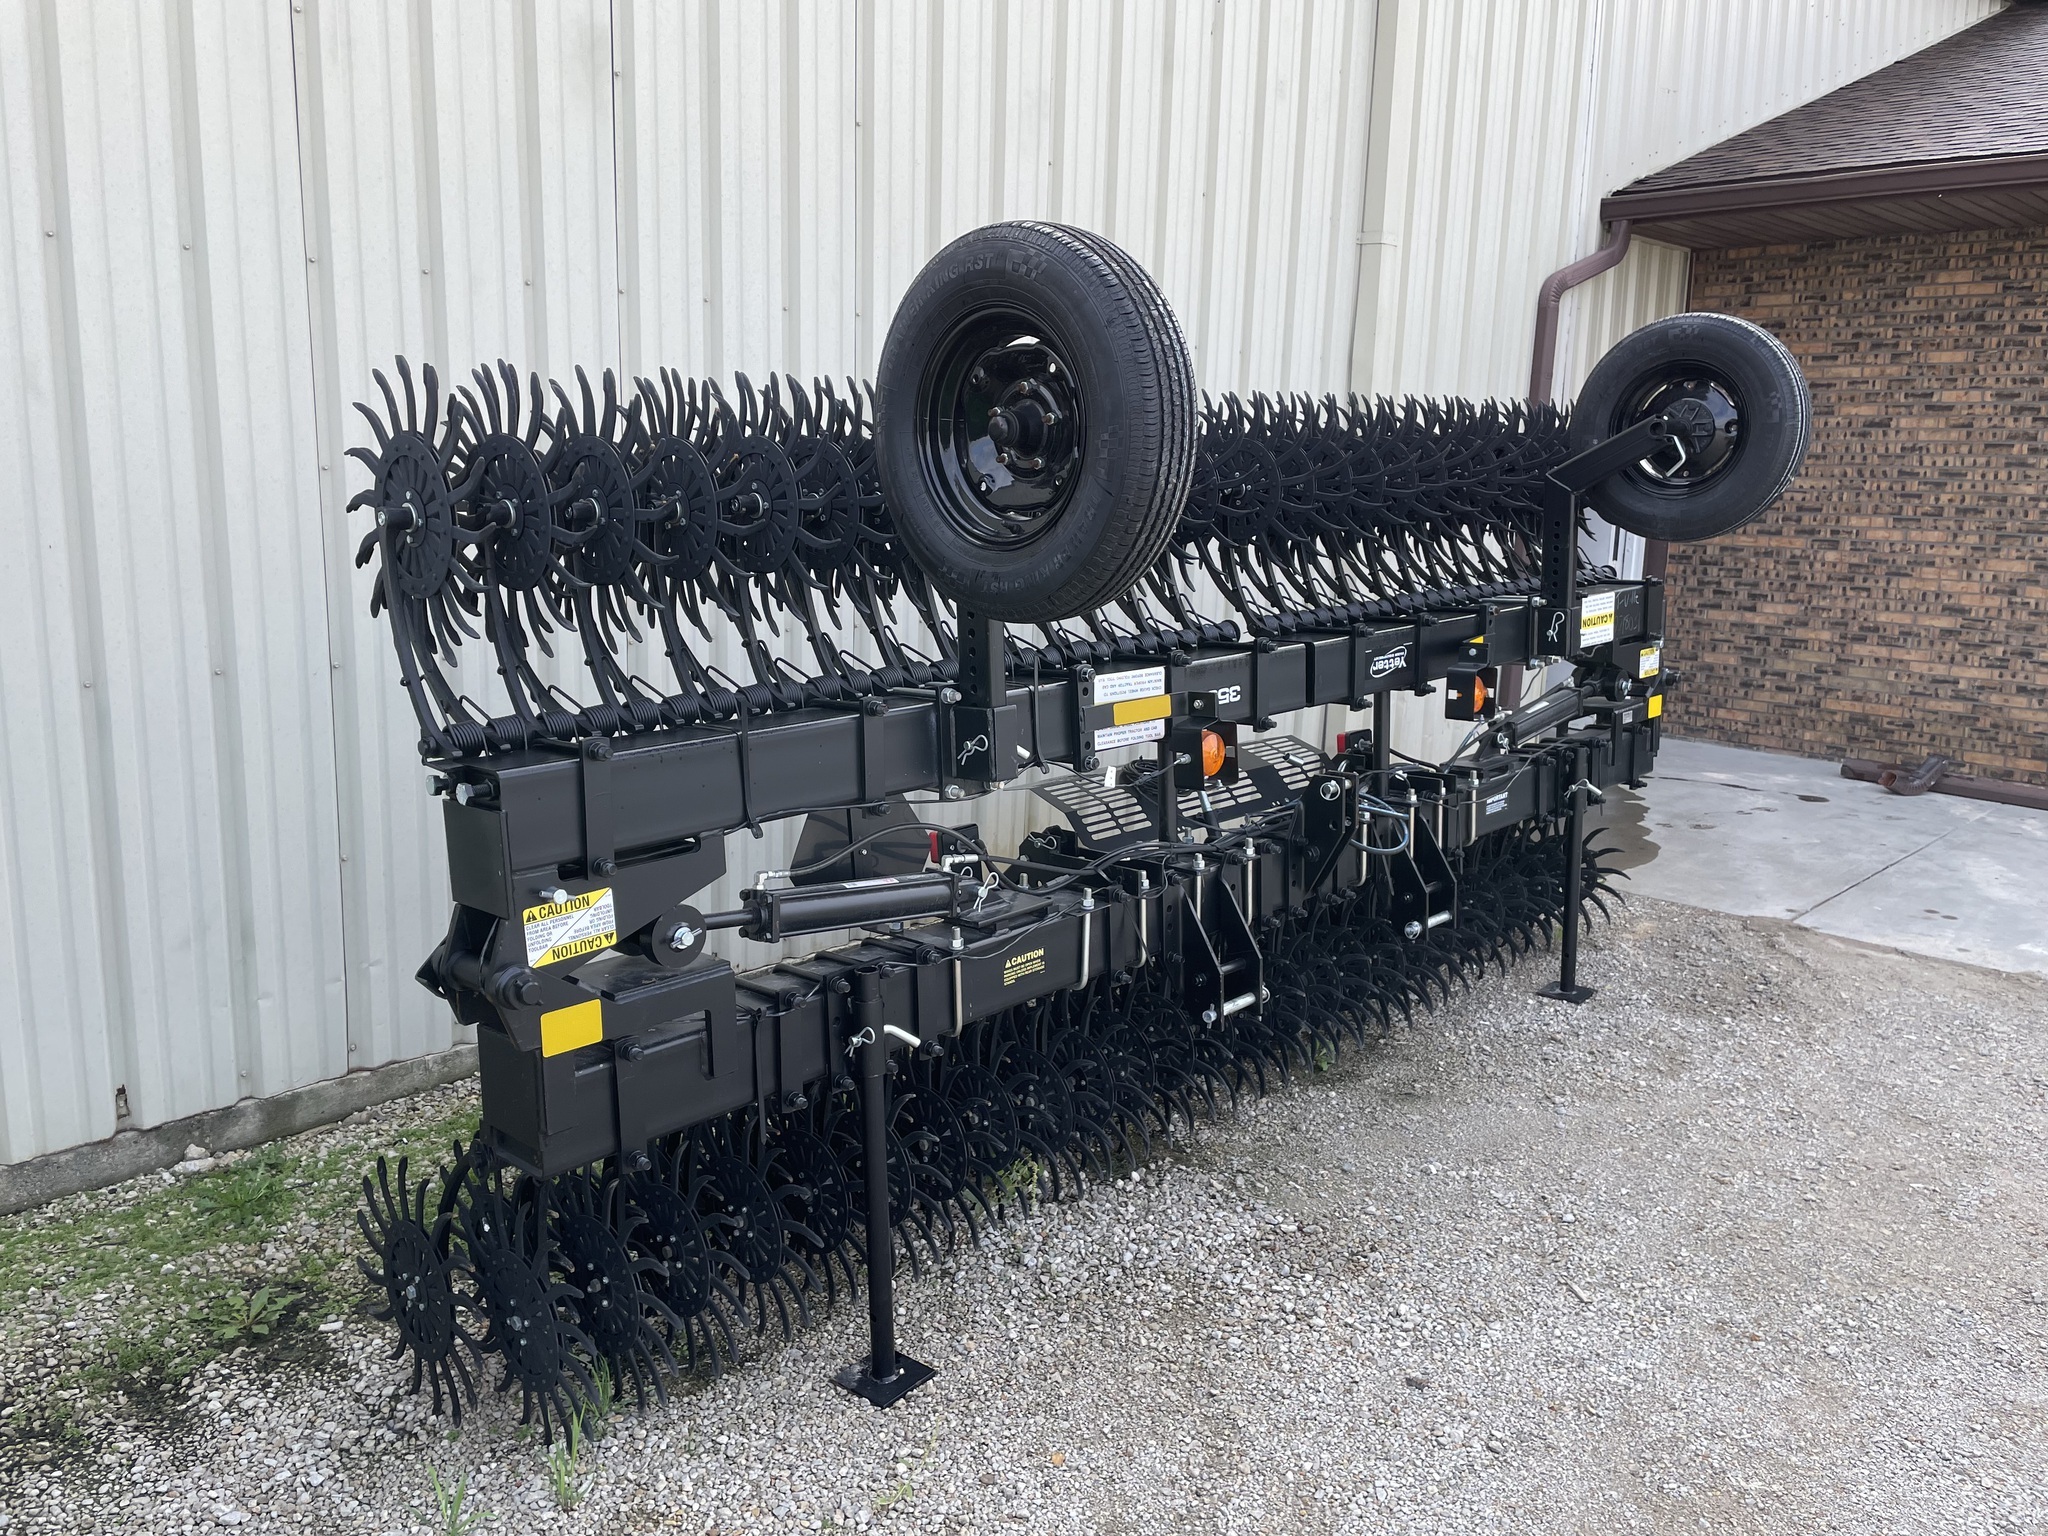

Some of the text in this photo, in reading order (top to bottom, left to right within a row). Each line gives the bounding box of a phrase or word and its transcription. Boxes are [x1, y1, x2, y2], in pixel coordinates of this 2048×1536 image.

[925, 263, 960, 297] KING
[964, 252, 994, 273] RST
[1582, 614, 1608, 628] CAUTION
[1372, 656, 1407, 671] Yetter
[1209, 685, 1240, 704] 35
[538, 895, 590, 919] CAUTION
[526, 923, 540, 931] CLEAR
[550, 914, 575, 924] PERSONNEL
[552, 921, 569, 930] BEFORE
[601, 924, 614, 932] CLEAR
[527, 934, 546, 942] FOLDING
[528, 938, 552, 947] UNFOLDING
[528, 944, 548, 952] TOOLBAR
[552, 936, 603, 960] CAUTION
[1011, 948, 1044, 965] CAUTION
